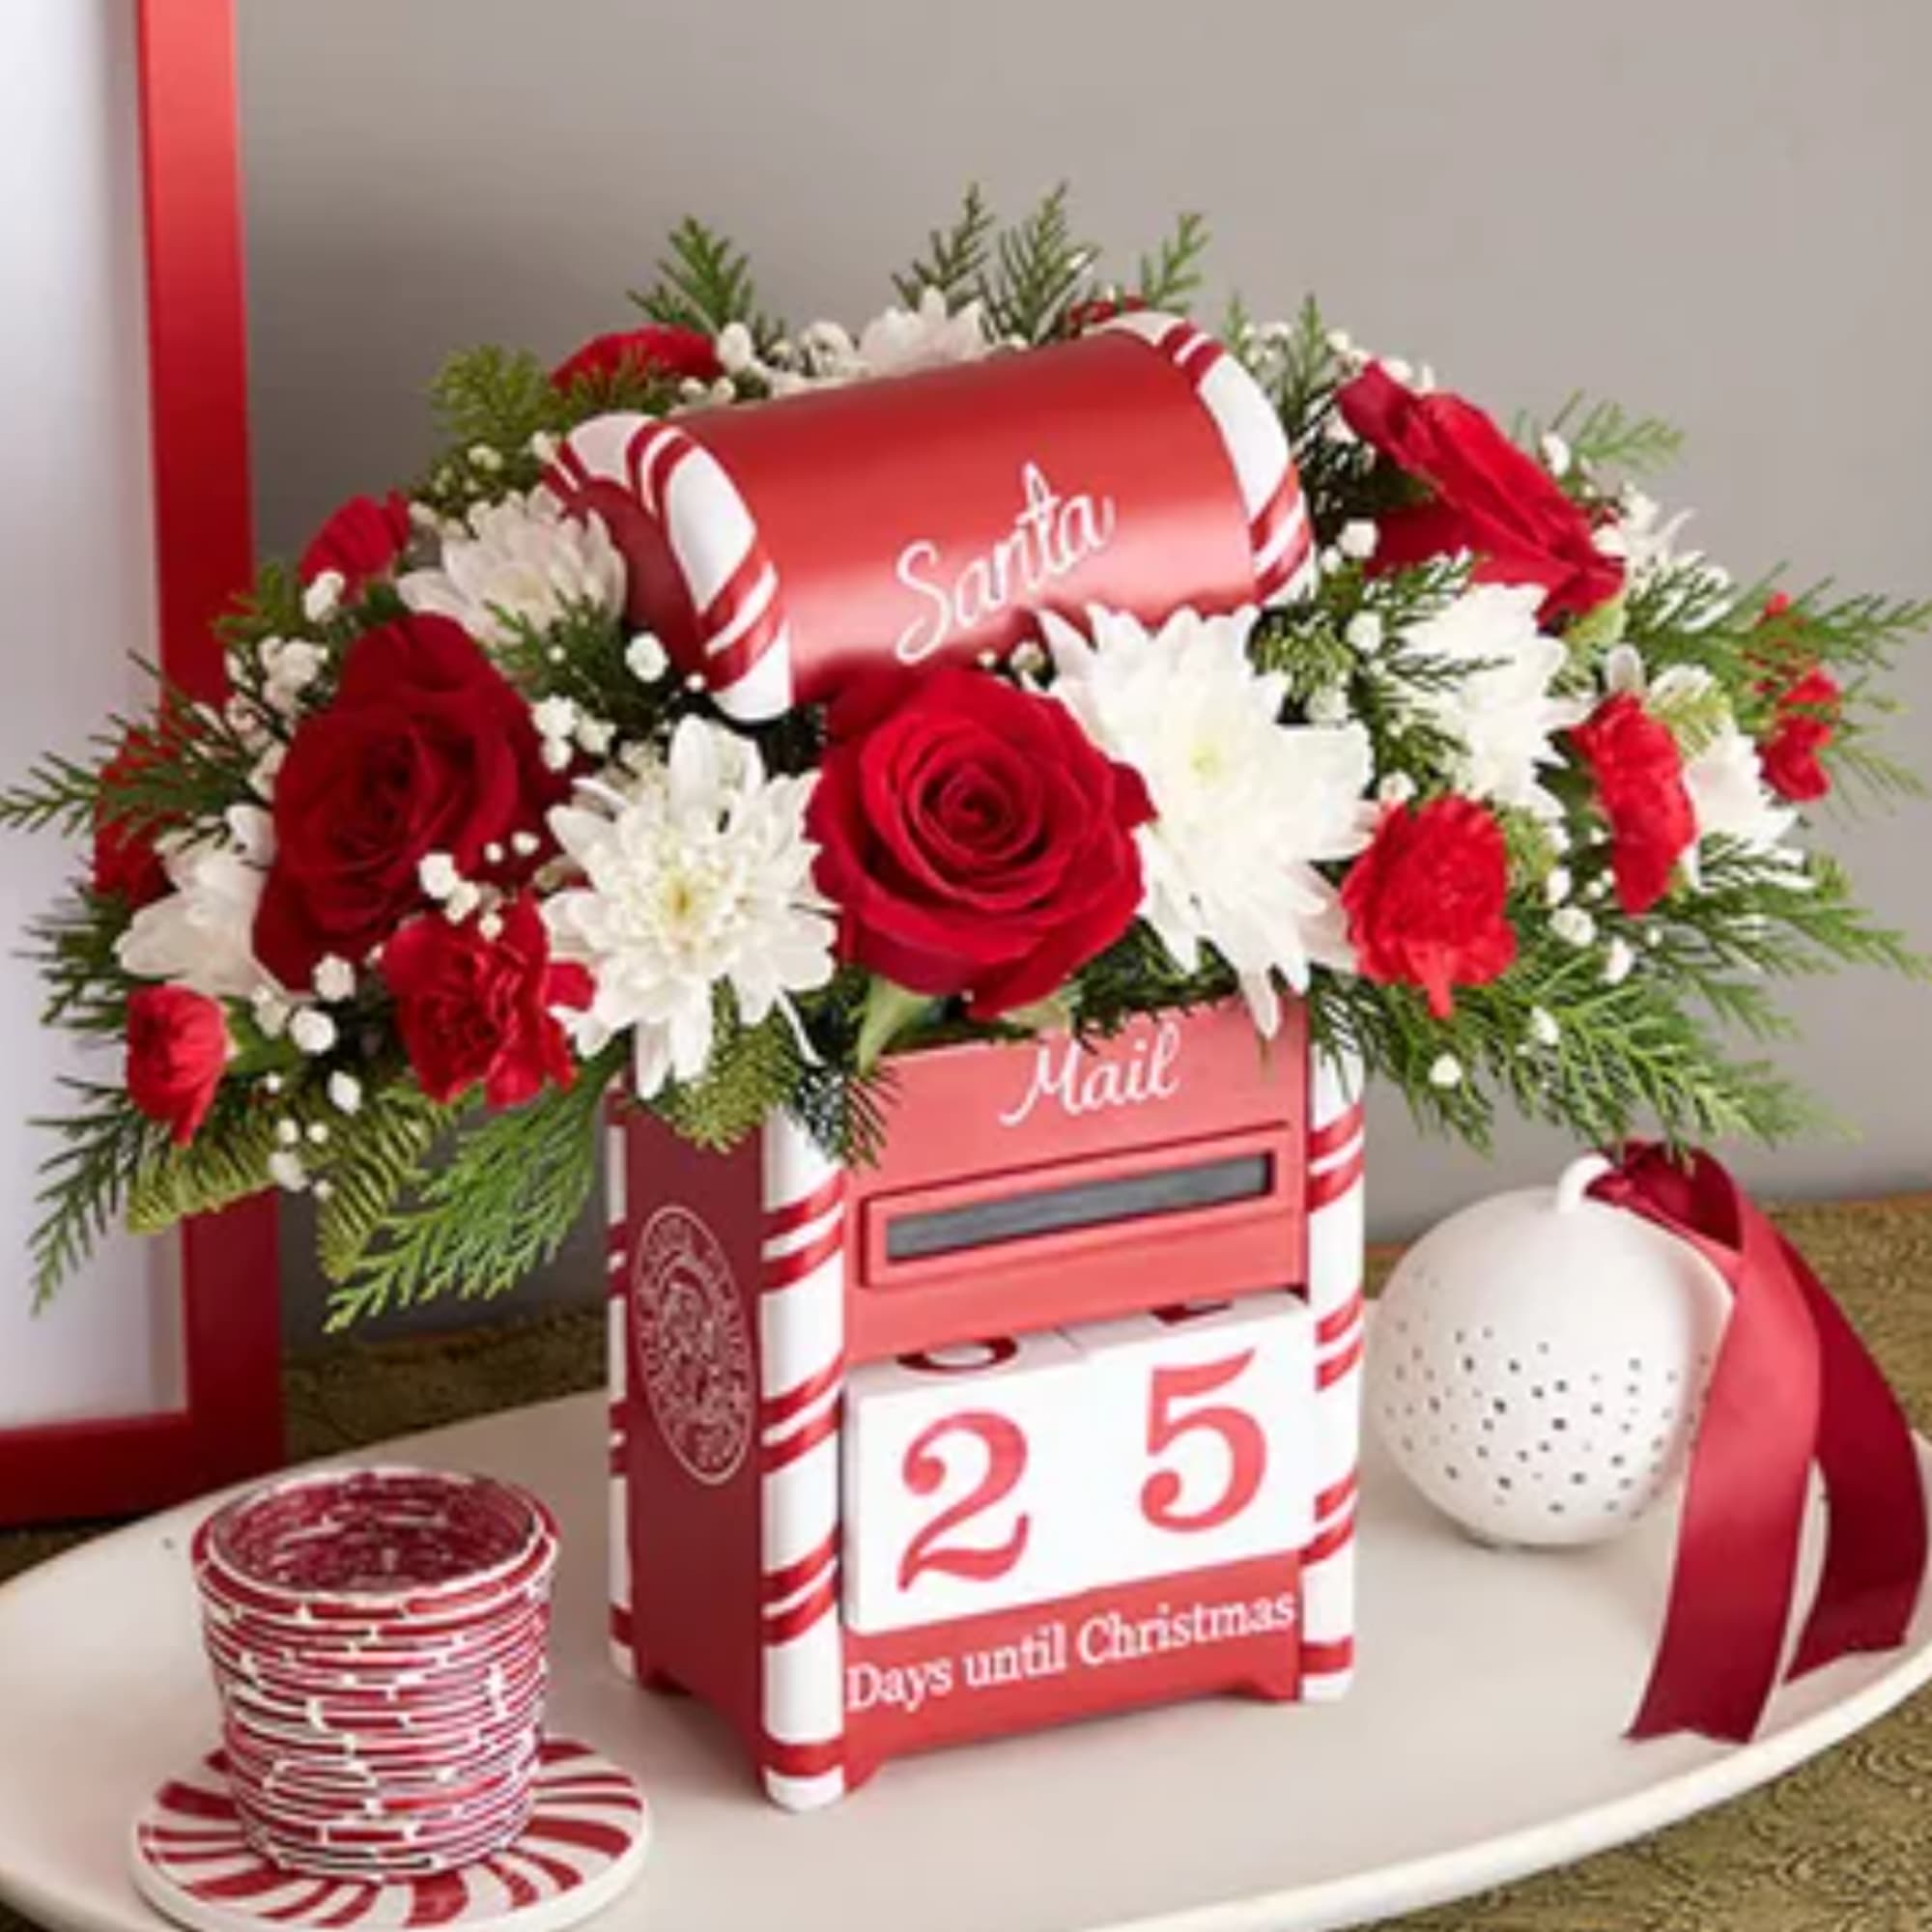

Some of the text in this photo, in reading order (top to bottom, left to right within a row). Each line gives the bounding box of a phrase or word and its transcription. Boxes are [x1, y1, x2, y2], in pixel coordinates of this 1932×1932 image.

[895, 461, 1116, 666] Santa
[998, 1020, 1180, 1126] Mail
[846, 1592, 1296, 1713] Days until Christmas
